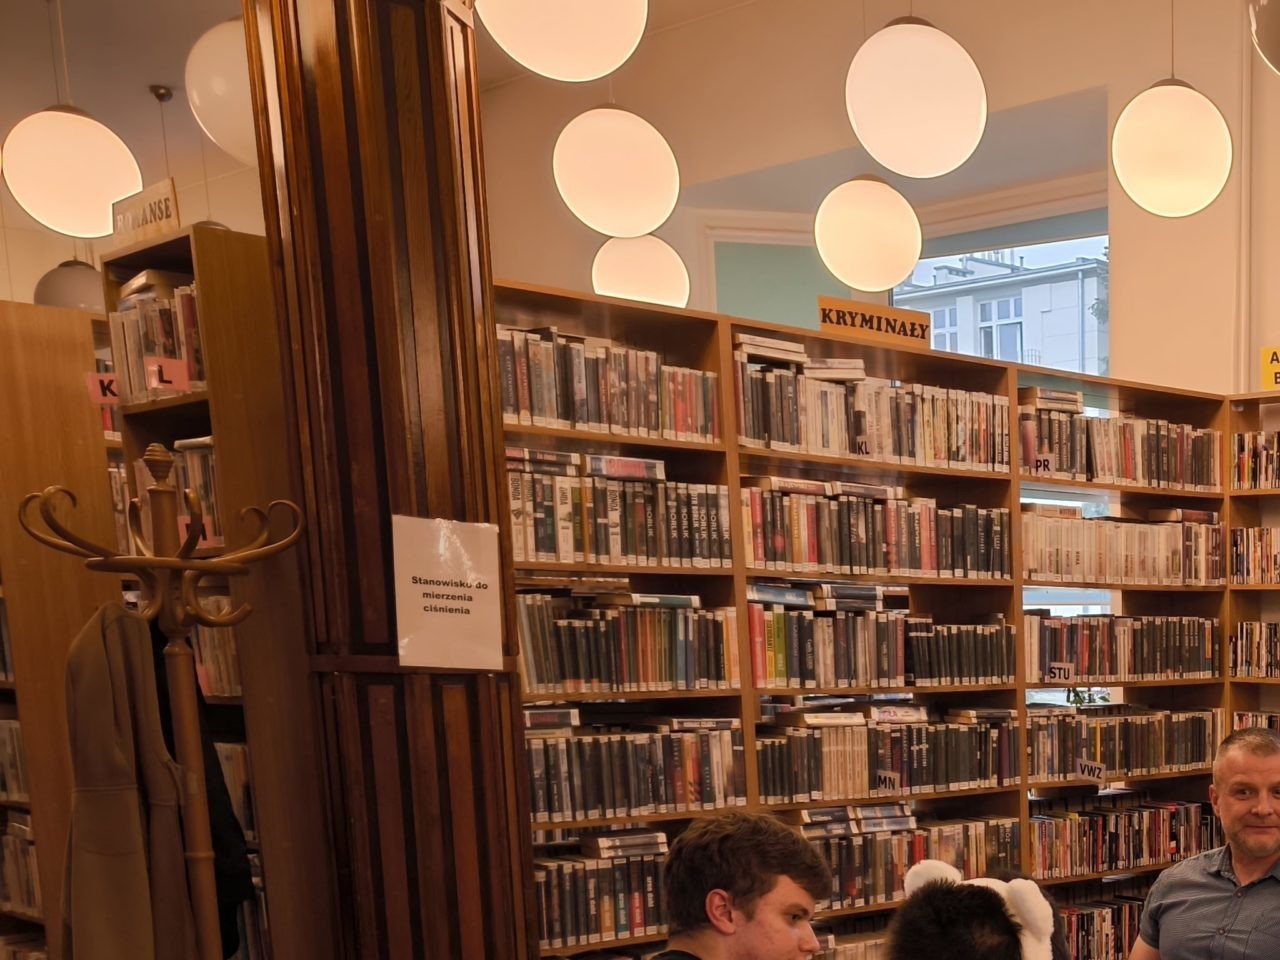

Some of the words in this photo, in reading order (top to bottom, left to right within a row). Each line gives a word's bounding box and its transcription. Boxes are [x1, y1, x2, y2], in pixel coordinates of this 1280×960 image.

[821, 308, 930, 340] KRYMINAŁY
[158, 364, 173, 385] L
[99, 379, 118, 397] K
[857, 440, 870, 456] KL
[1035, 458, 1050, 473] PR
[422, 591, 473, 602] mierzenia
[423, 604, 471, 615] ciśnienia
[1049, 666, 1070, 681] STU
[1079, 763, 1103, 780] VWZ
[878, 774, 896, 792] MN
